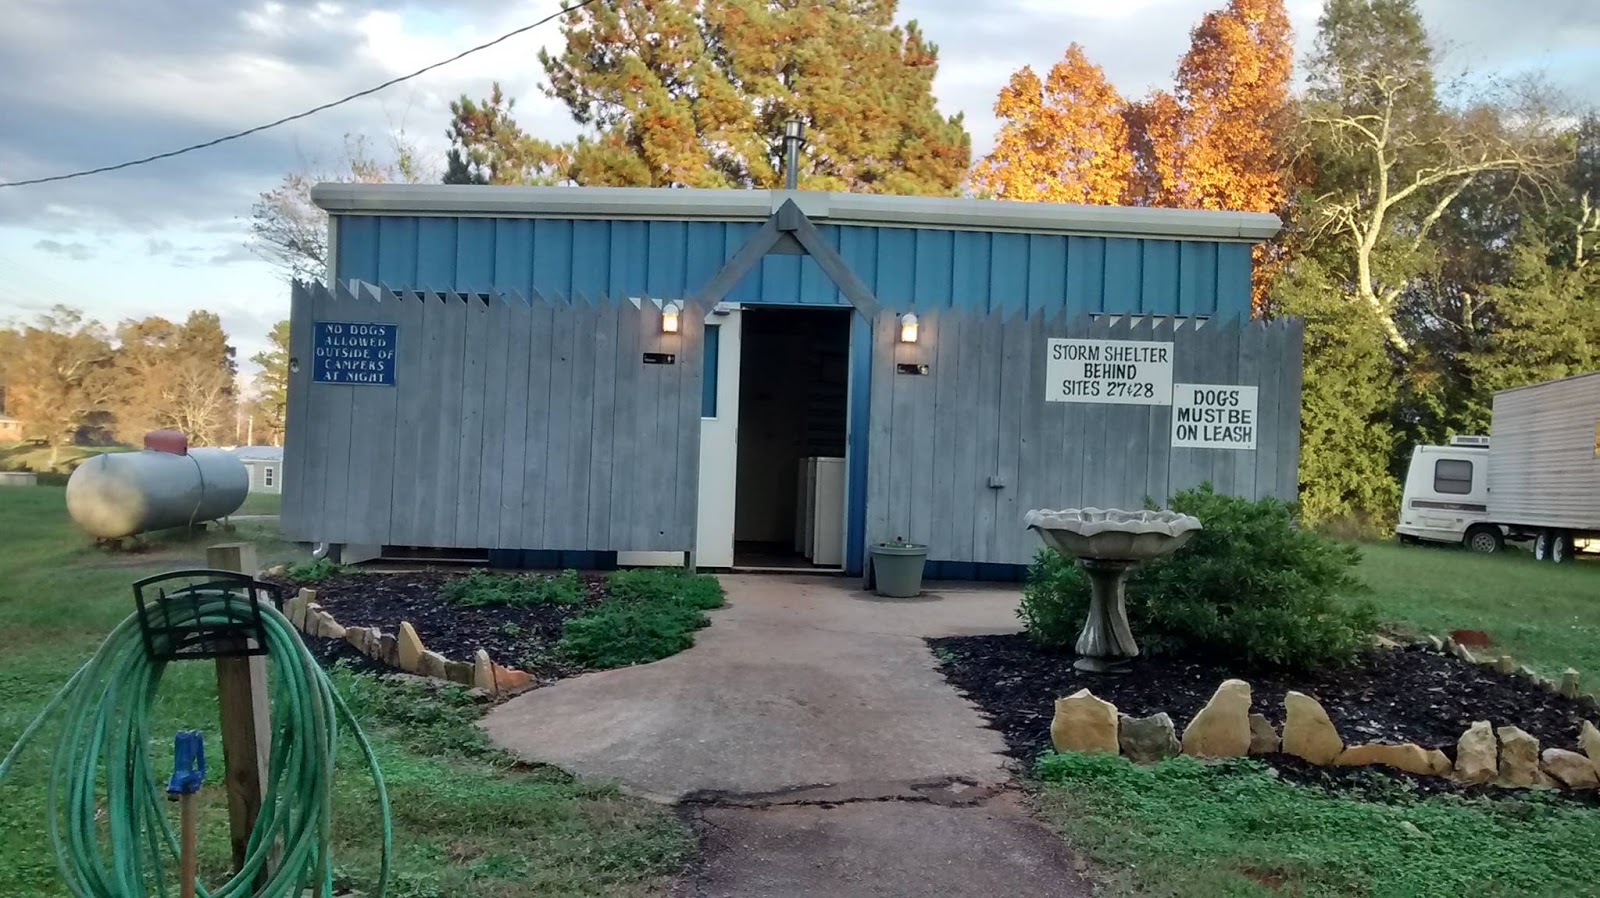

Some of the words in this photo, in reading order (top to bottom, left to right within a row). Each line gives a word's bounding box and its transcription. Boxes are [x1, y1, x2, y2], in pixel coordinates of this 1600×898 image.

[326, 324, 342, 334] NO
[350, 325, 385, 336] DOGS
[325, 336, 386, 347] ALLOWED
[317, 347, 370, 358] OUTSIDE
[378, 349, 394, 359] OF
[1053, 344, 1100, 361] STORM
[1104, 346, 1168, 363] SHELTER
[325, 359, 384, 371] CAMPERS
[1084, 363, 1137, 380] BEHIND
[324, 371, 340, 381] AT
[346, 372, 384, 382] NIGHT
[1062, 379, 1100, 396] SITES
[1193, 389, 1239, 407] DOGS
[1177, 407, 1226, 423] MUST
[1228, 409, 1252, 424] BE
[1176, 424, 1198, 441] ON
[1203, 425, 1252, 443] LEASH
